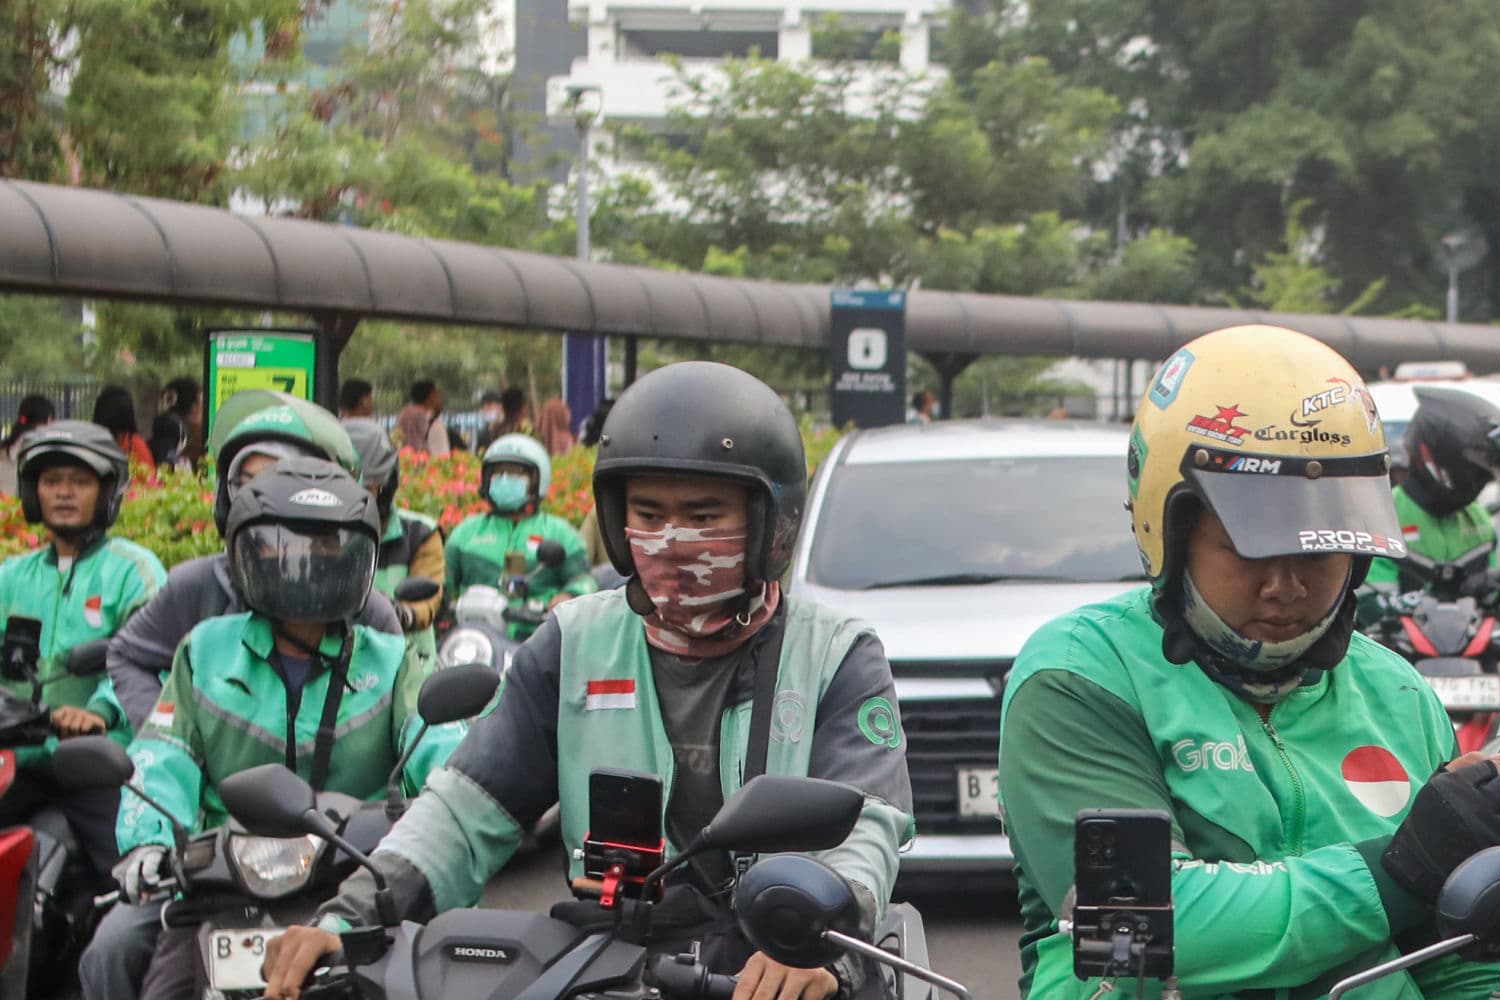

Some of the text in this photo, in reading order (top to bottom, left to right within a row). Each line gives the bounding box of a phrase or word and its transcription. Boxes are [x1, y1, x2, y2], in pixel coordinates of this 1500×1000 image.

[1302, 386, 1346, 417] KTC
[1254, 424, 1351, 447] Cargloss
[1299, 530, 1405, 553] PROPER
[1172, 734, 1254, 772] Grab
[967, 774, 981, 798] B
[217, 936, 232, 958] B
[455, 947, 507, 958] HONDA
